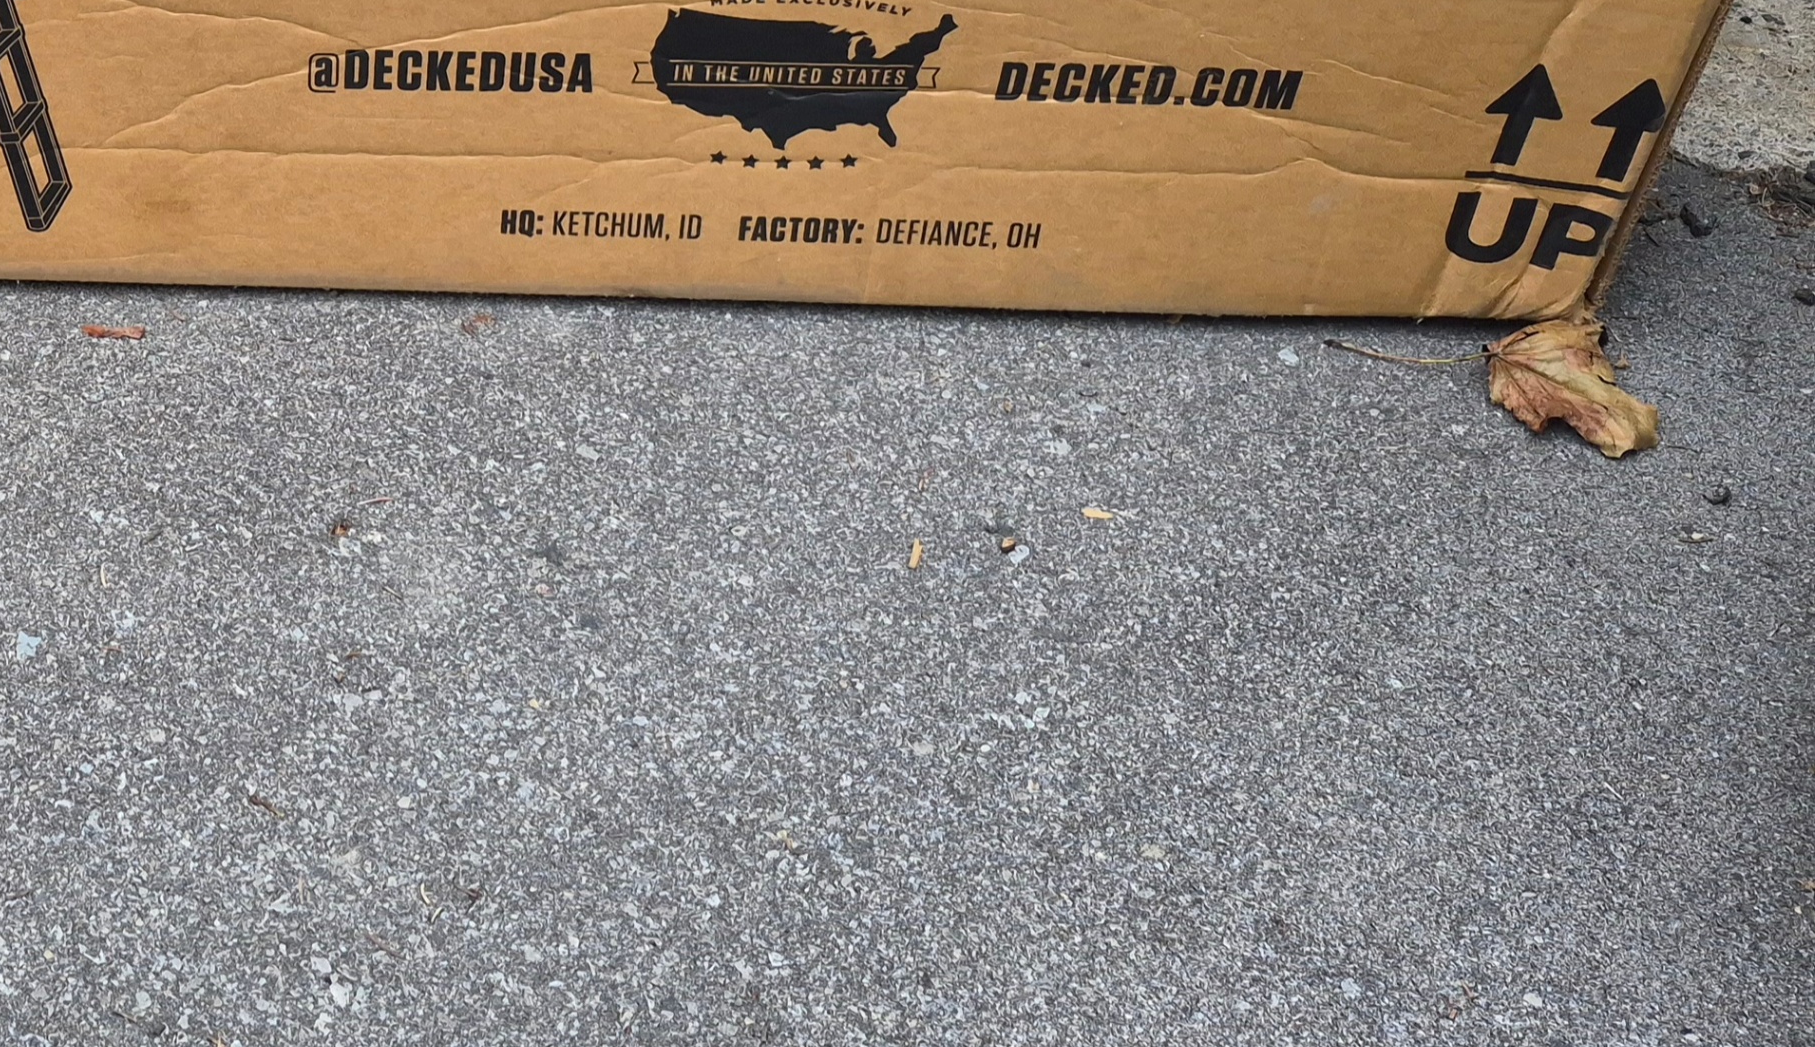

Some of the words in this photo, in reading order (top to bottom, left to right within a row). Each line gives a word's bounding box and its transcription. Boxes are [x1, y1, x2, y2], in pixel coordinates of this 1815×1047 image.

[308, 49, 593, 93] @DECKEDUSA
[673, 63, 695, 82] IN
[703, 64, 739, 83] THE
[748, 65, 823, 85] UNITED
[831, 68, 907, 87] STATES
[995, 61, 1303, 110] DECKED.COM
[500, 208, 545, 238] HQ:
[552, 210, 672, 242] KETCHUM,
[679, 214, 703, 240] ID
[738, 215, 865, 245] FACTORY:
[876, 218, 999, 250] DEFIANCE,
[1006, 222, 1042, 249] OH
[1445, 191, 1614, 271] UP
